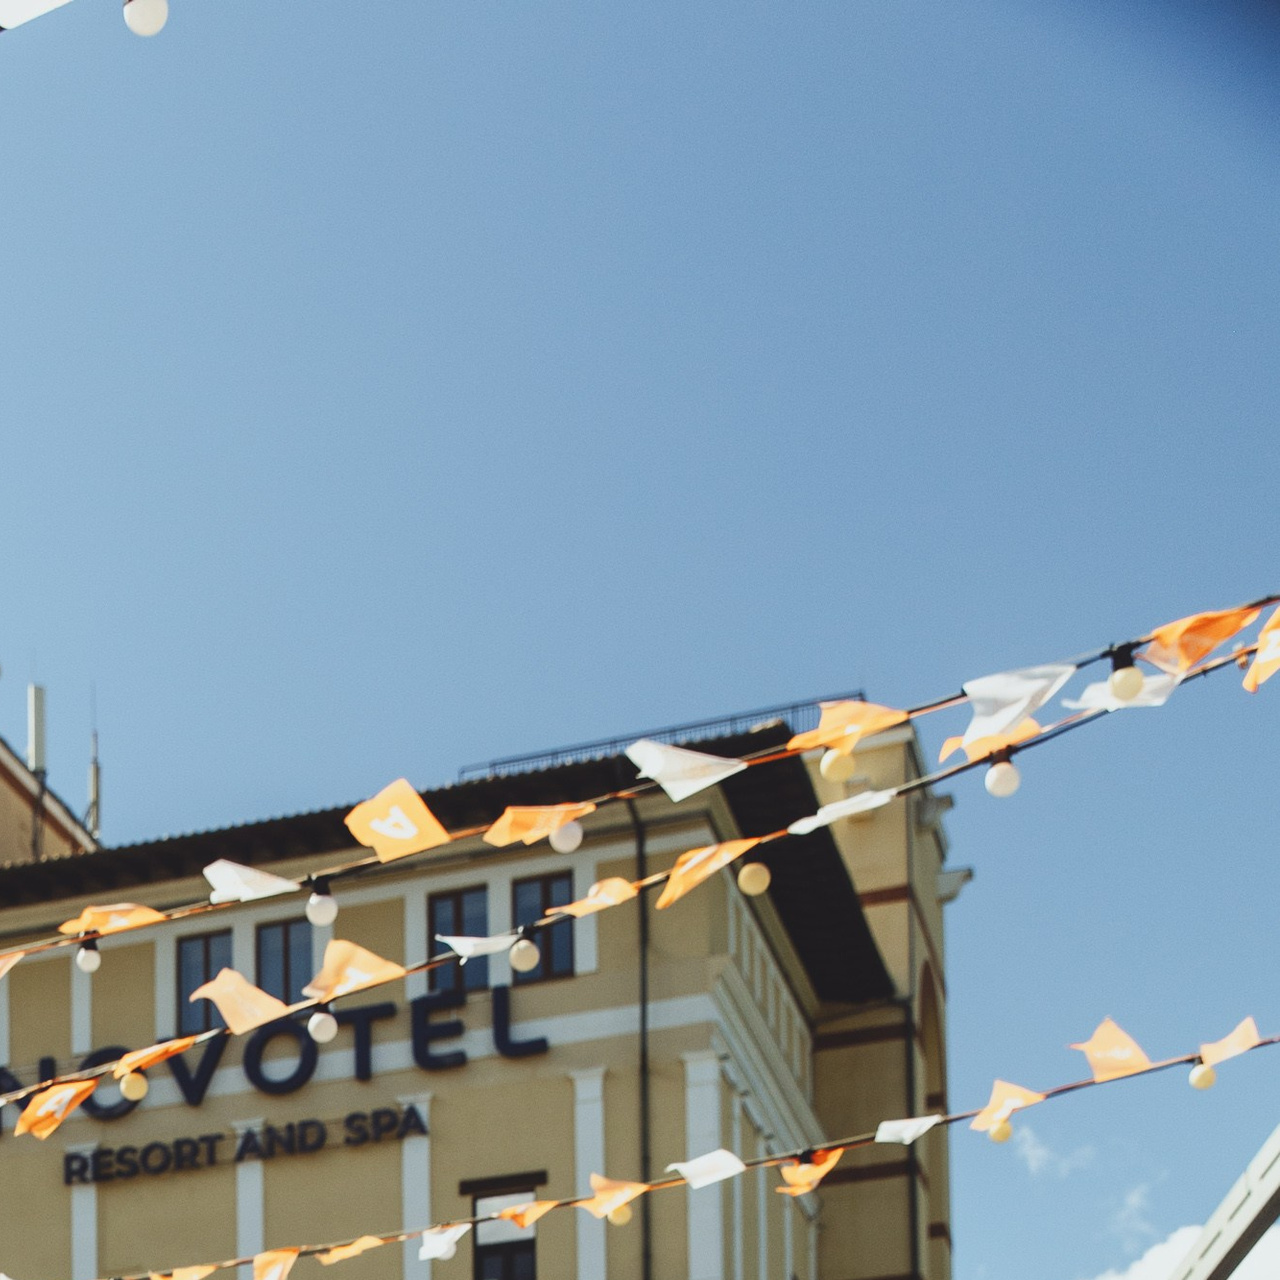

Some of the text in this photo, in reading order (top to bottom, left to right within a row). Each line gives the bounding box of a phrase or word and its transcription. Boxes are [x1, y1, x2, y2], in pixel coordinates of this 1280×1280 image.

[63, 1104, 429, 1185] RESORT AND SPA
